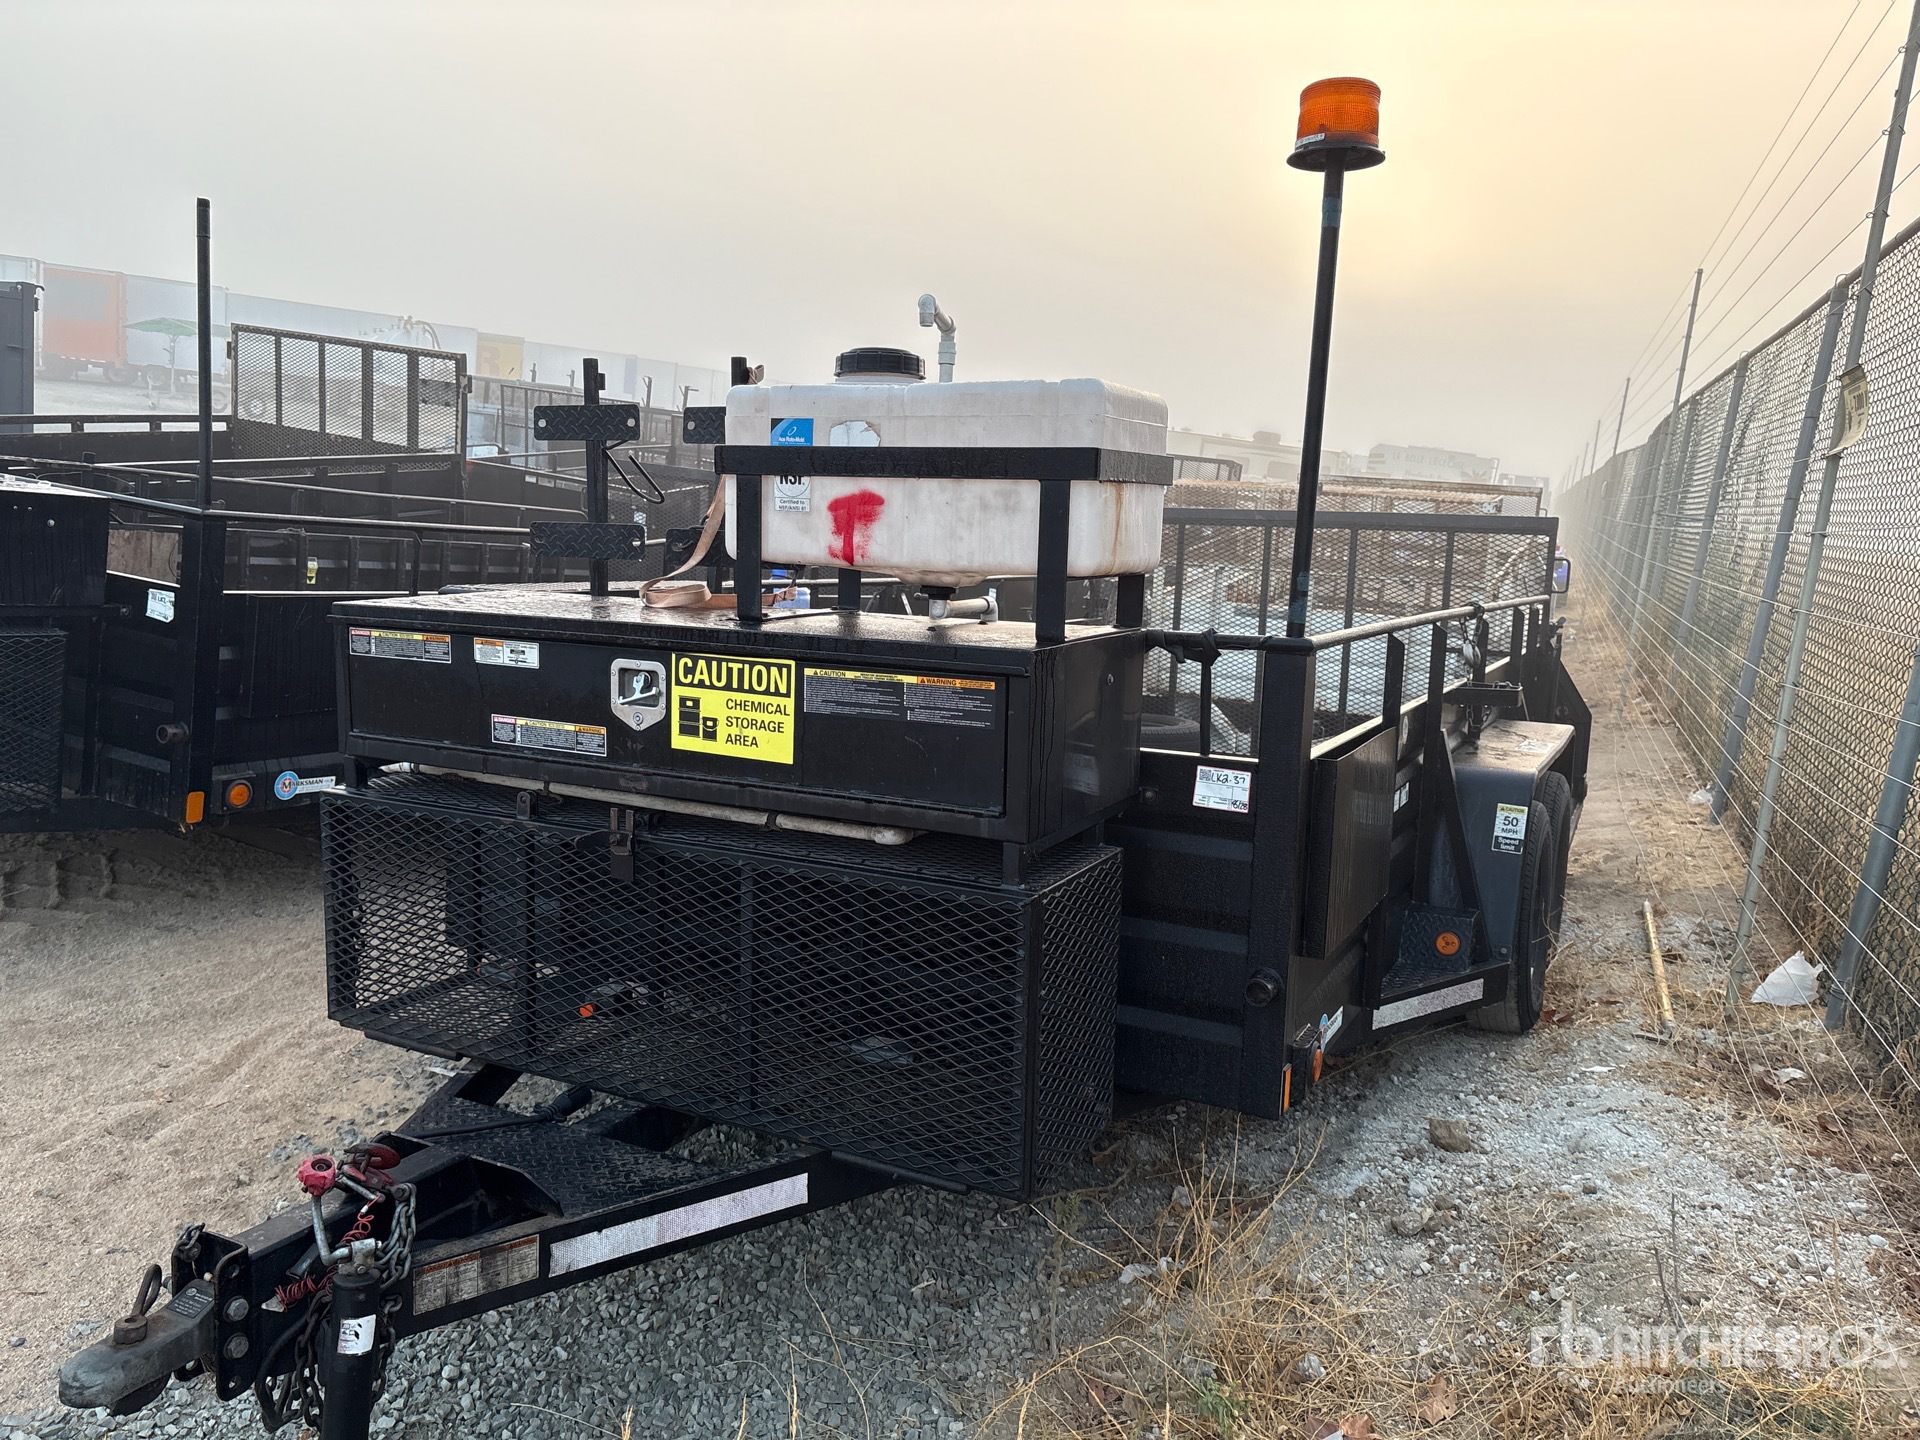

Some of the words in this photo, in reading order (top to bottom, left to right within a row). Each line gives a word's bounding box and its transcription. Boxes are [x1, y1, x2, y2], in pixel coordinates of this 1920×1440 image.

[678, 657, 788, 694] CAUTION
[819, 669, 846, 678] CAUTION
[925, 678, 957, 686] WARNING
[725, 698, 791, 717] CHEMICAL
[725, 715, 785, 734] STORAGE
[725, 733, 759, 748] AREA
[282, 778, 324, 790] MARKSMAN
[1503, 816, 1519, 827] 50
[1498, 836, 1519, 845] Speed
[1500, 843, 1515, 851] limit
